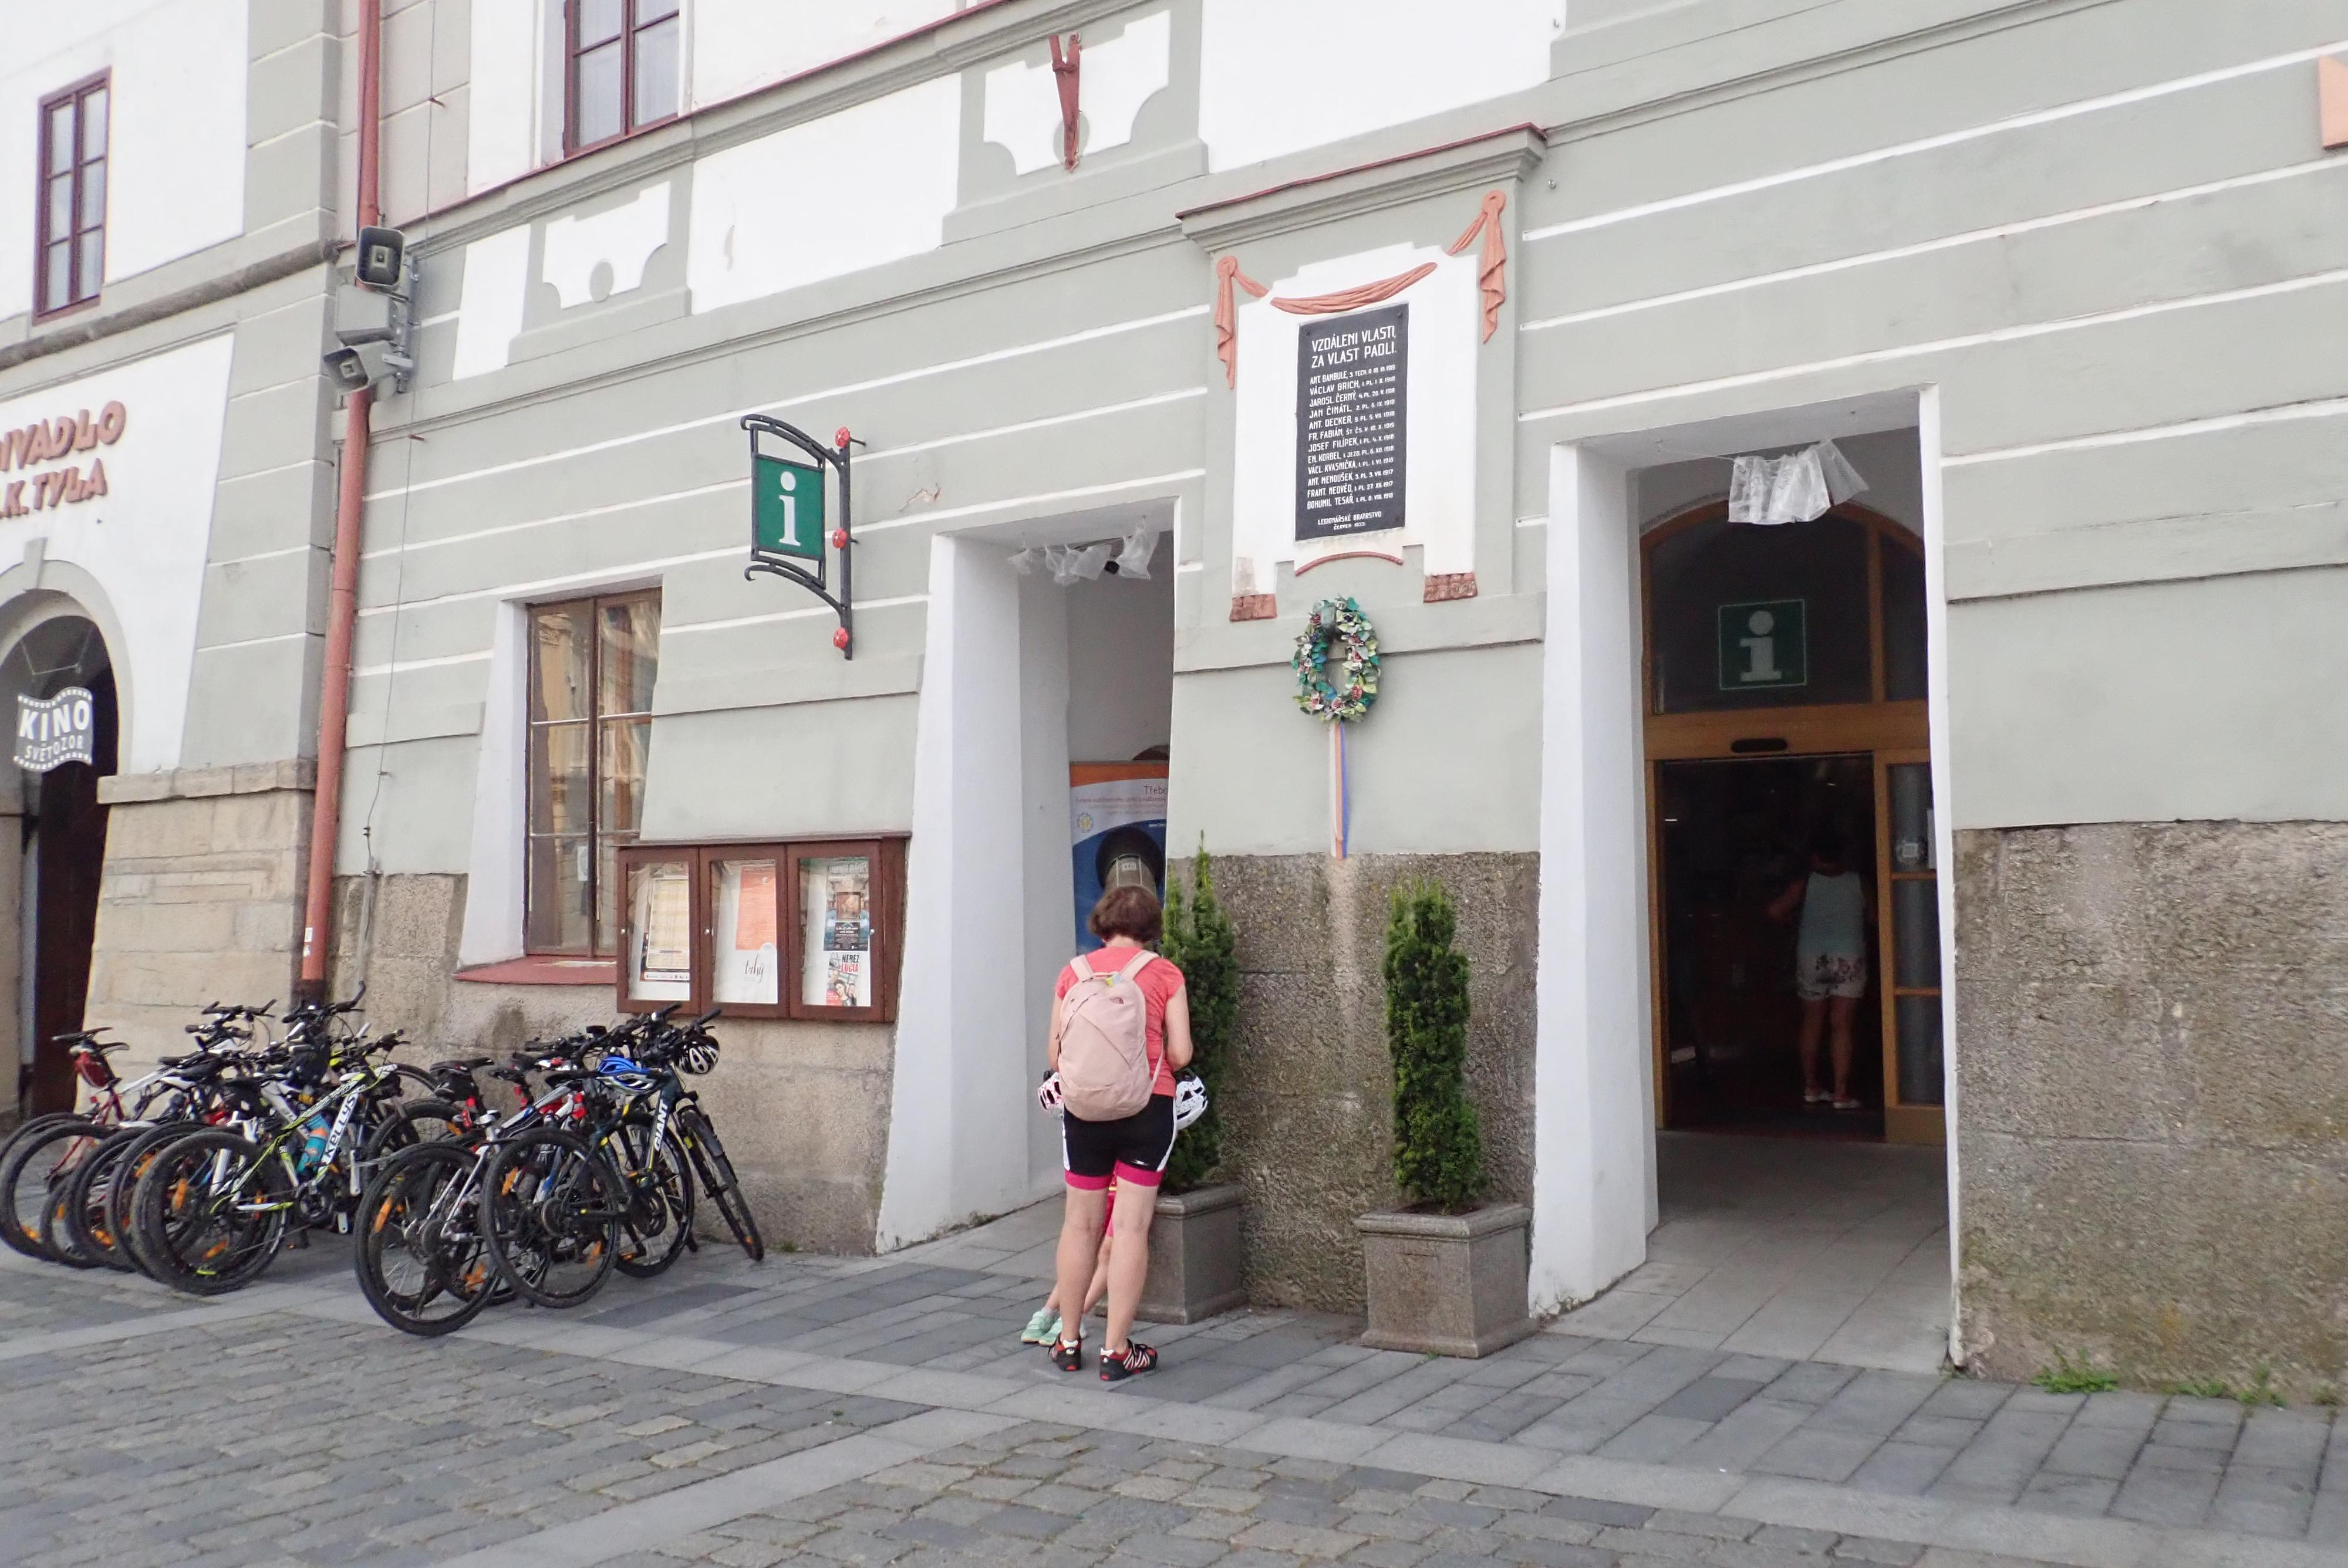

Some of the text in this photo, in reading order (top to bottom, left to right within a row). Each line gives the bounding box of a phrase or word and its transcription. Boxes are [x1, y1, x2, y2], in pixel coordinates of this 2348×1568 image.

[1312, 332, 1358, 352] VZDÁLENI
[1311, 342, 1396, 368] ZA VLAST PADLI.
[1323, 371, 1348, 383] BAMBULE,
[1310, 385, 1334, 395] VÁCLAV
[1338, 380, 1360, 391] BRICH,
[1310, 408, 1323, 418] JAN
[1309, 421, 1322, 430] ANT.
[0, 401, 126, 471] IVADLO
[1320, 427, 1343, 440] FABIÁN,
[1308, 441, 1329, 452] JOSEF
[1333, 437, 1359, 448] FILÍPEK,
[1325, 459, 1357, 472] KVASNIČKA,
[32, 458, 107, 511] TYLA
[1308, 478, 1319, 486] ANT.
[1307, 499, 1331, 509] BOHUMIL
[19, 700, 90, 741] KINO
[25, 735, 83, 762] SVĚTOZOR
[654, 1099, 668, 1152] GIANT
